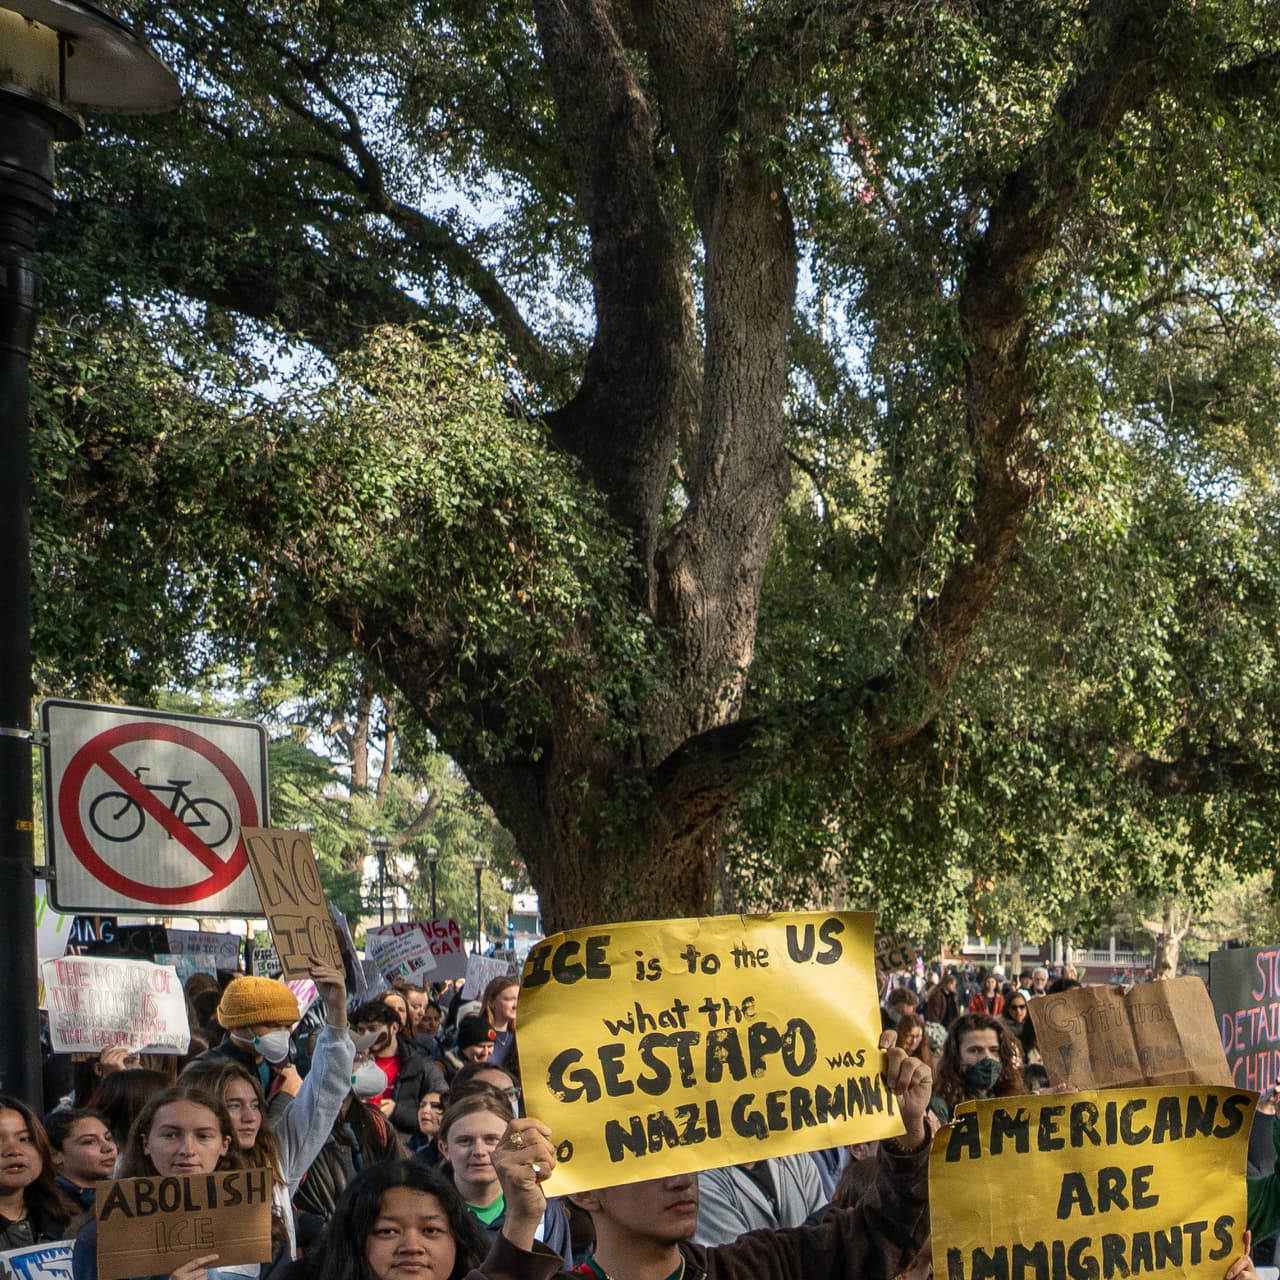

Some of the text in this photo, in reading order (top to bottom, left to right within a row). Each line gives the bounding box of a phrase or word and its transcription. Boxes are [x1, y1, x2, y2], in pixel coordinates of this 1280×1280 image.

[247, 836, 321, 906] NO
[52, 960, 90, 987] THE
[152, 968, 173, 993] OF
[523, 935, 612, 988] ICE
[635, 950, 663, 981] is
[680, 944, 721, 976] to
[730, 942, 769, 969] the
[57, 1028, 89, 1046] THE
[604, 996, 757, 1036] what the
[546, 1018, 866, 1104] GESTAPO was
[605, 1100, 722, 1163] NAZI
[730, 1073, 897, 1140] GERMANY
[945, 1094, 1252, 1162] AMERICANS
[99, 1173, 267, 1221] ABOLISH
[1056, 1165, 1160, 1220] ARE
[155, 1217, 216, 1255] ICE
